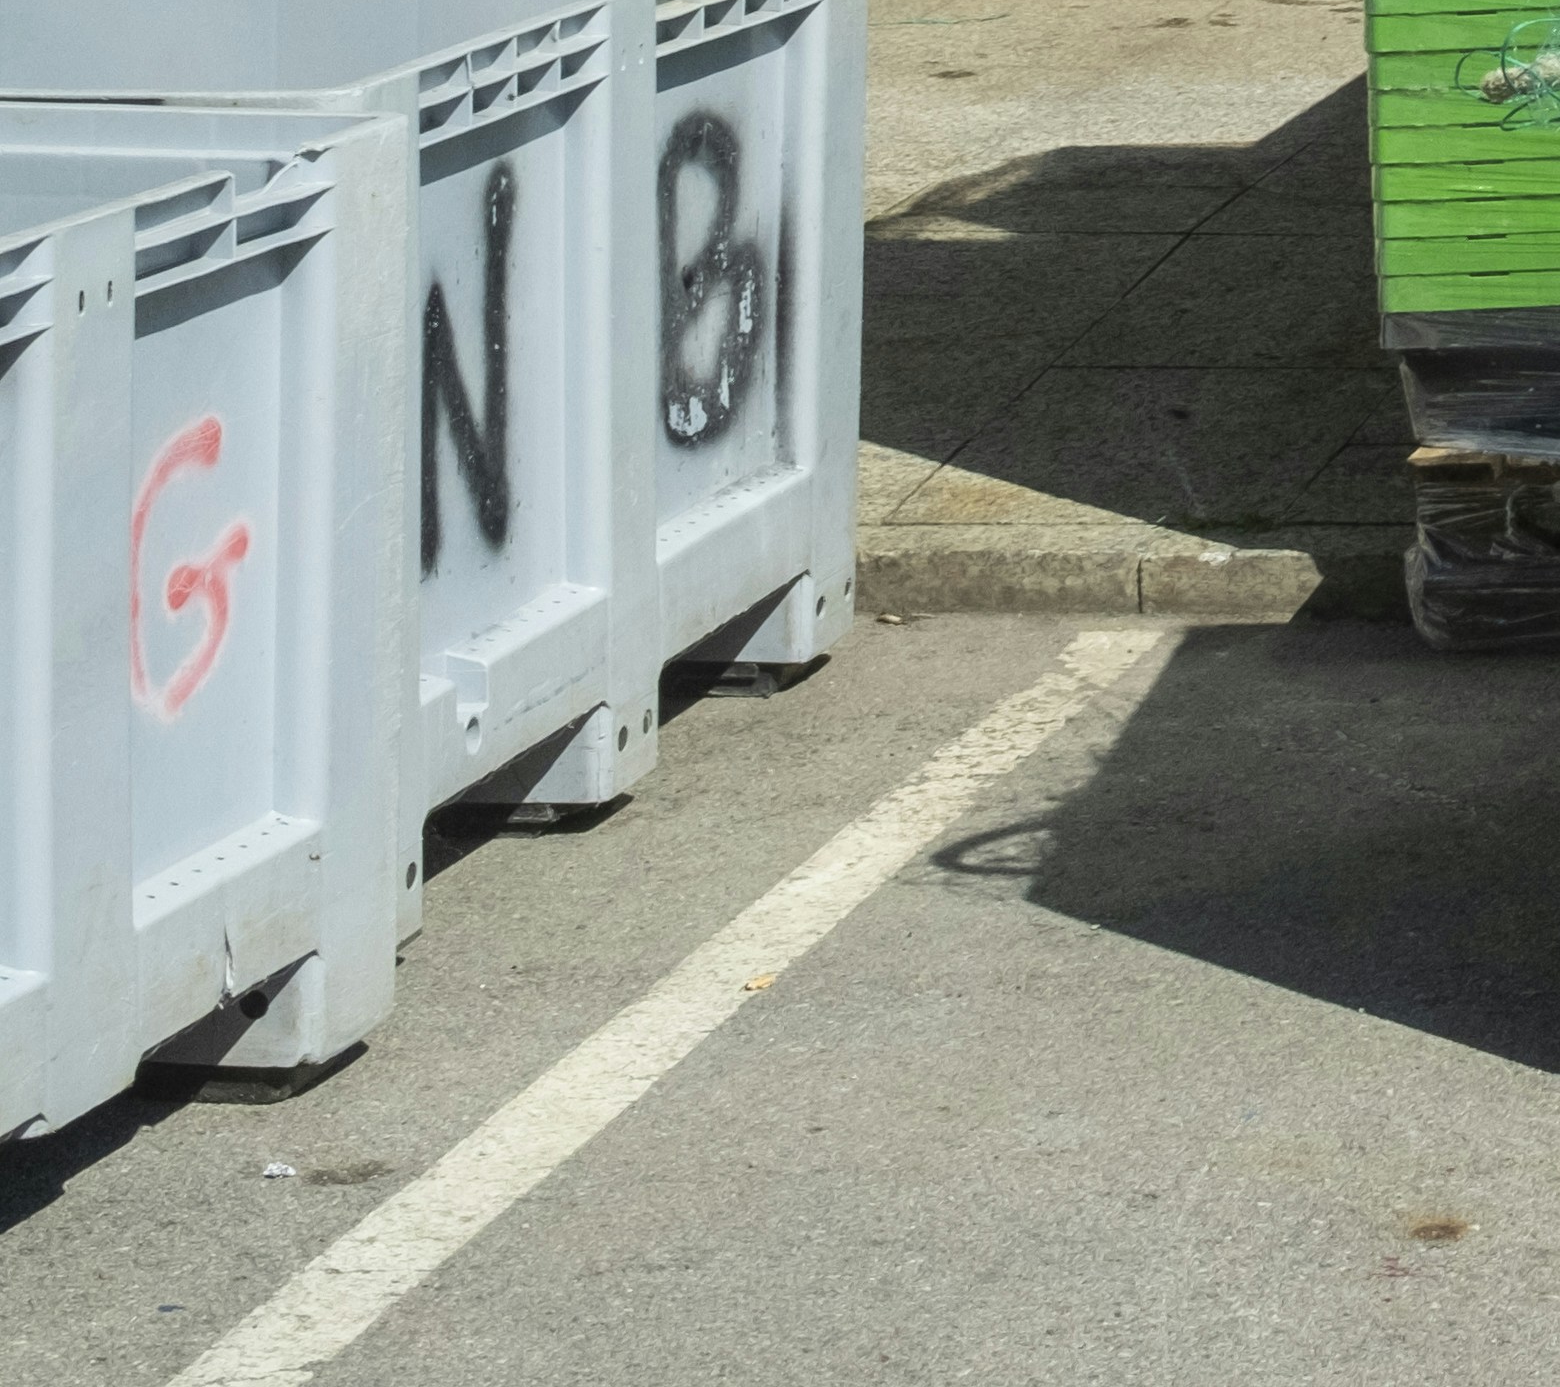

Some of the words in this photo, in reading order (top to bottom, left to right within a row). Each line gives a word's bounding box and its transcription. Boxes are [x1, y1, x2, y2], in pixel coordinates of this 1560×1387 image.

[418, 155, 519, 581] N
[655, 107, 766, 449] B
[131, 413, 250, 722] G
